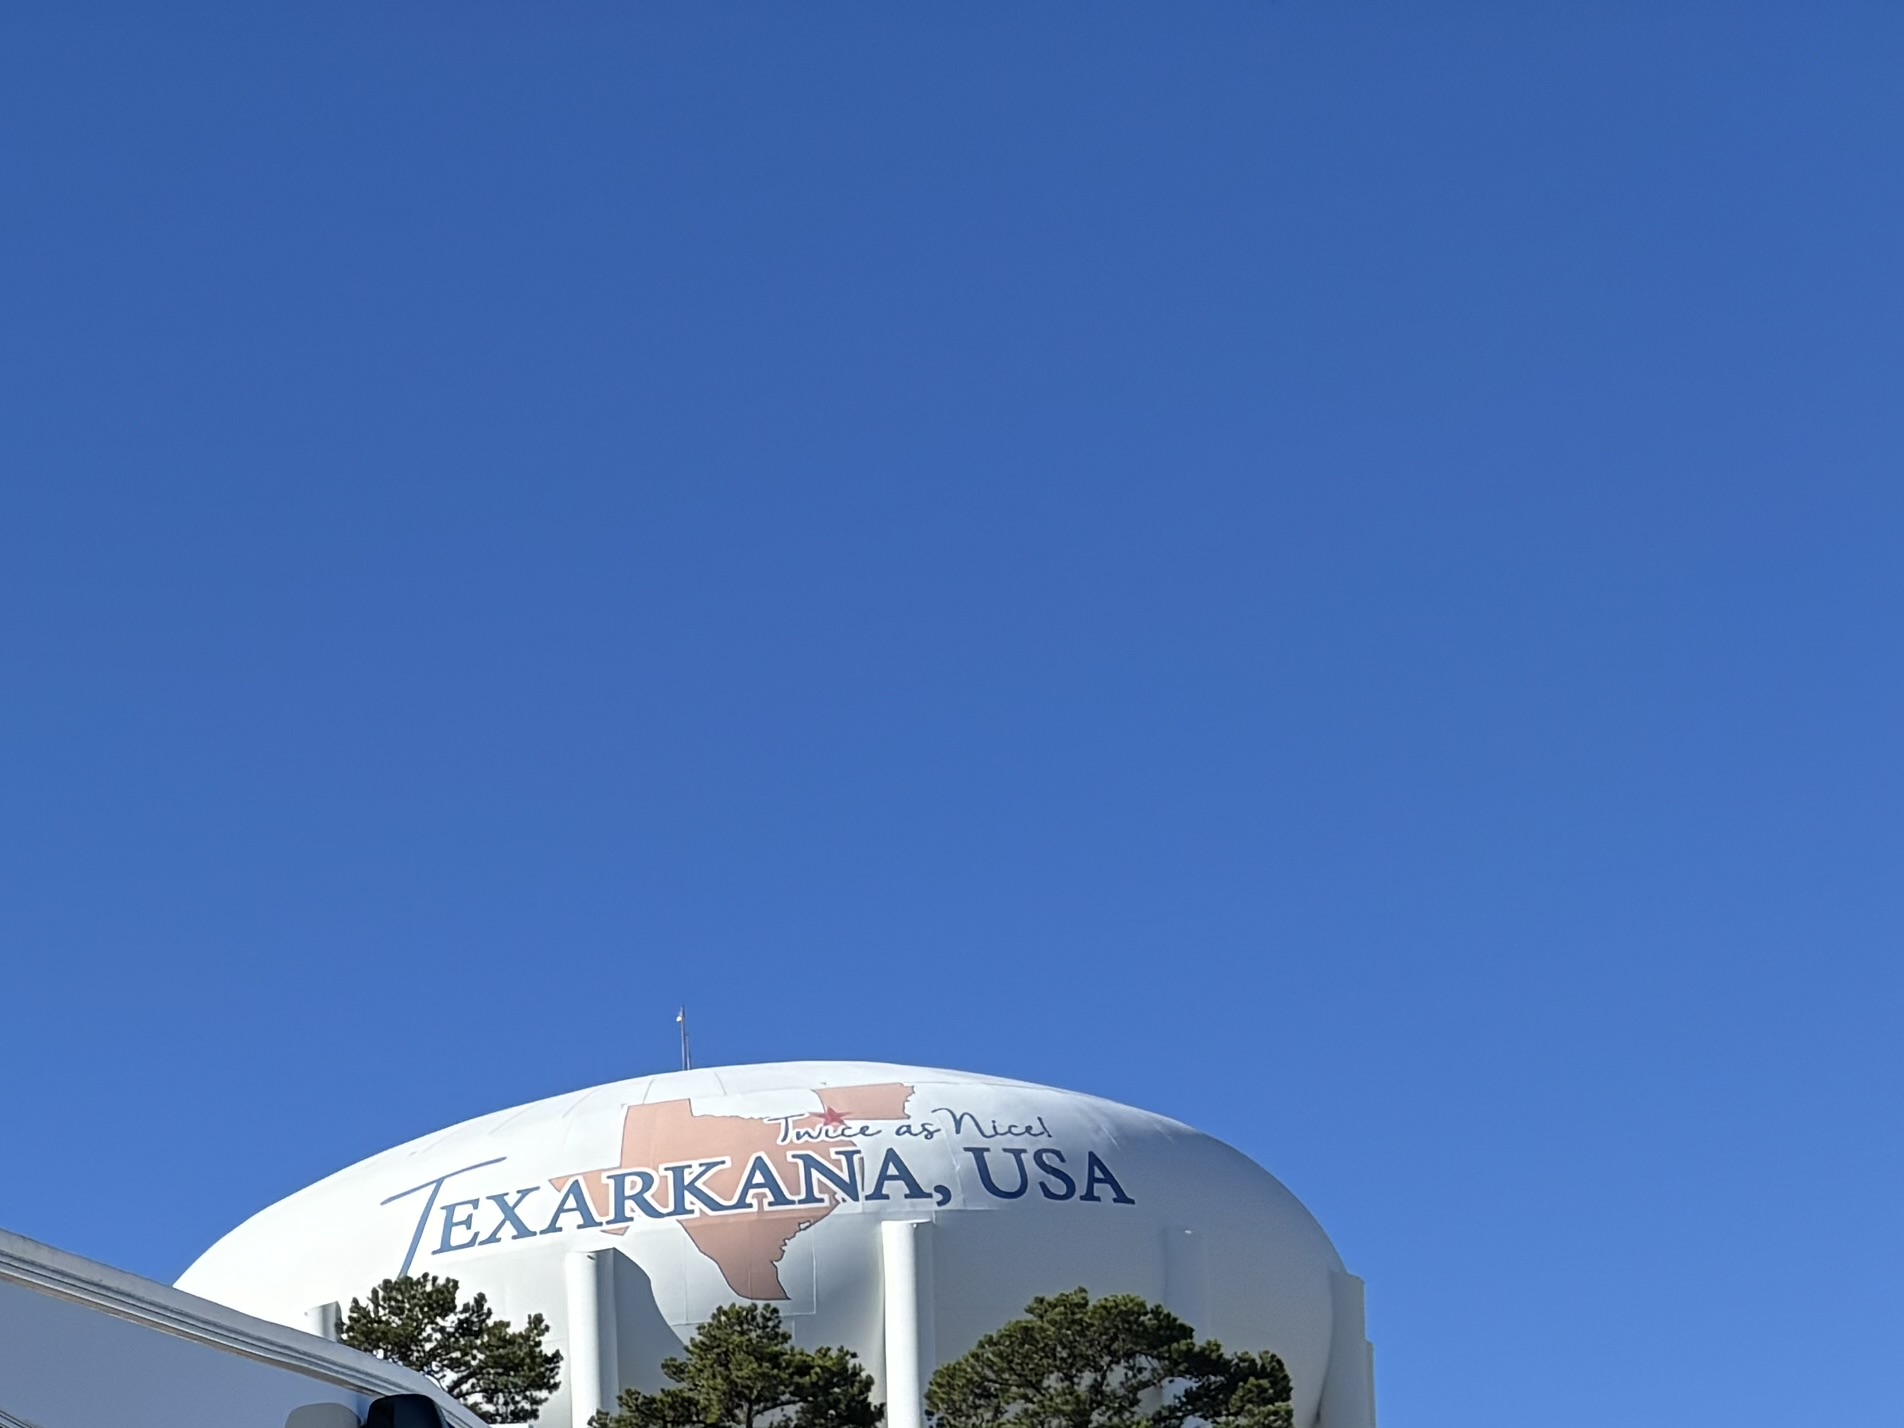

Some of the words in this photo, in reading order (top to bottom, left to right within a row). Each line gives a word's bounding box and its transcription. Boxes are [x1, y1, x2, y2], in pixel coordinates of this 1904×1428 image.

[766, 1114, 883, 1144] Twice
[894, 1120, 942, 1140] as
[930, 1107, 1054, 1139] Nice!
[380, 1146, 953, 1278] TEXARKANA,
[963, 1146, 1136, 1206] USA
